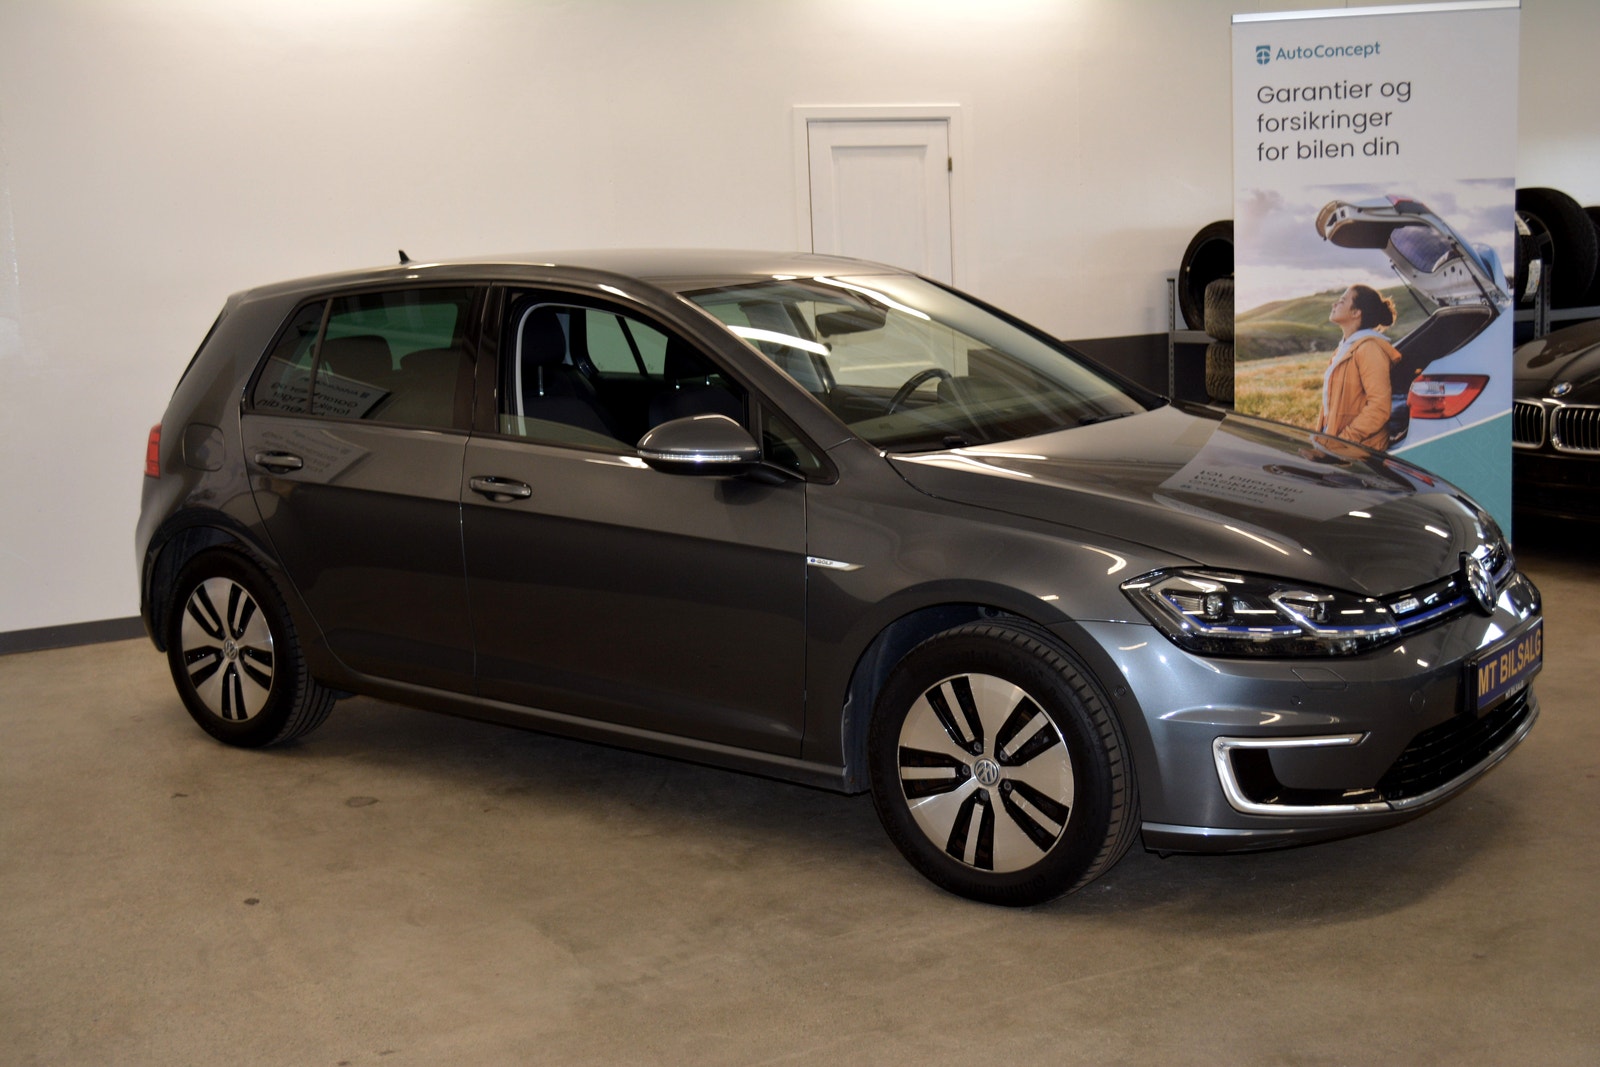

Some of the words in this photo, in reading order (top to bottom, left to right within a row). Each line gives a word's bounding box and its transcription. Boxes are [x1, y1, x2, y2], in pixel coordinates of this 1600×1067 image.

[1276, 41, 1381, 61] AutoConcept
[1257, 80, 1373, 104] Garantier
[1380, 81, 1412, 103] og
[1257, 110, 1393, 134] forsikringer
[1257, 142, 1289, 162] for
[1297, 139, 1354, 160] bilen
[1362, 136, 1400, 157] din
[1478, 660, 1497, 696] MT
[1500, 629, 1541, 683] BILSALG
